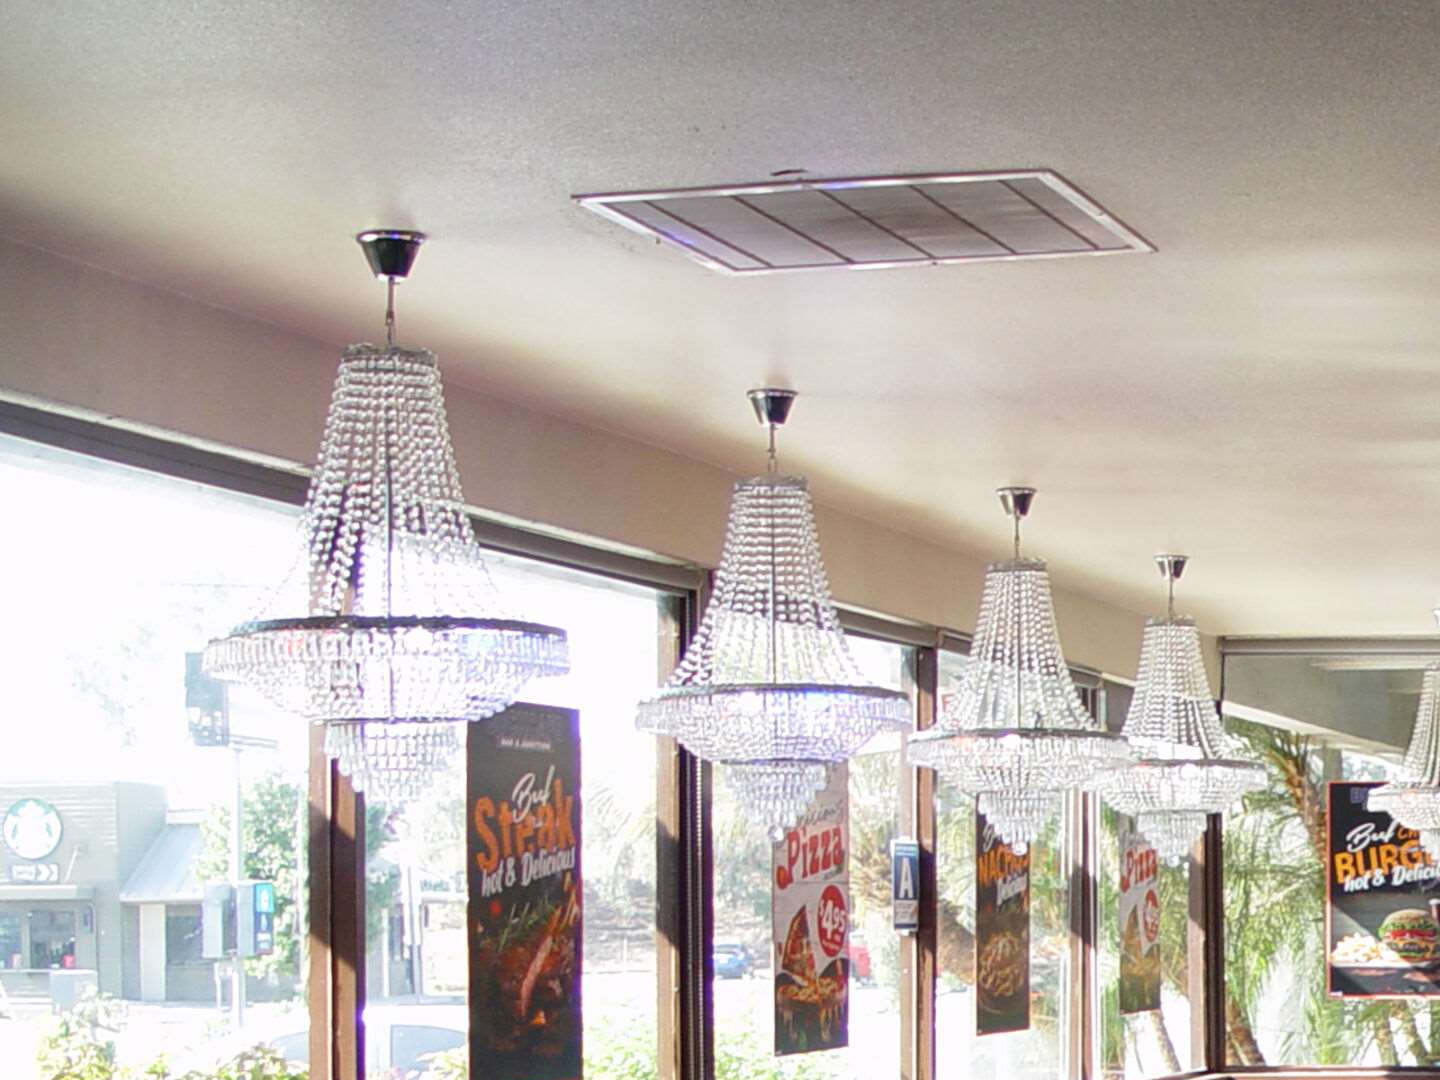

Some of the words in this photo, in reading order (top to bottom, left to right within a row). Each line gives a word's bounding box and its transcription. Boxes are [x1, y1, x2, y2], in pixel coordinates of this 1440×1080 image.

[474, 777, 576, 872] Steak
[481, 860, 504, 898] hot
[505, 856, 517, 887] &
[520, 846, 576, 887] Delicious
[775, 824, 843, 890] Pizza
[898, 857, 914, 898] A
[1334, 839, 1434, 885] BURG
[1343, 873, 1370, 893] hot
[1371, 867, 1386, 887] &
